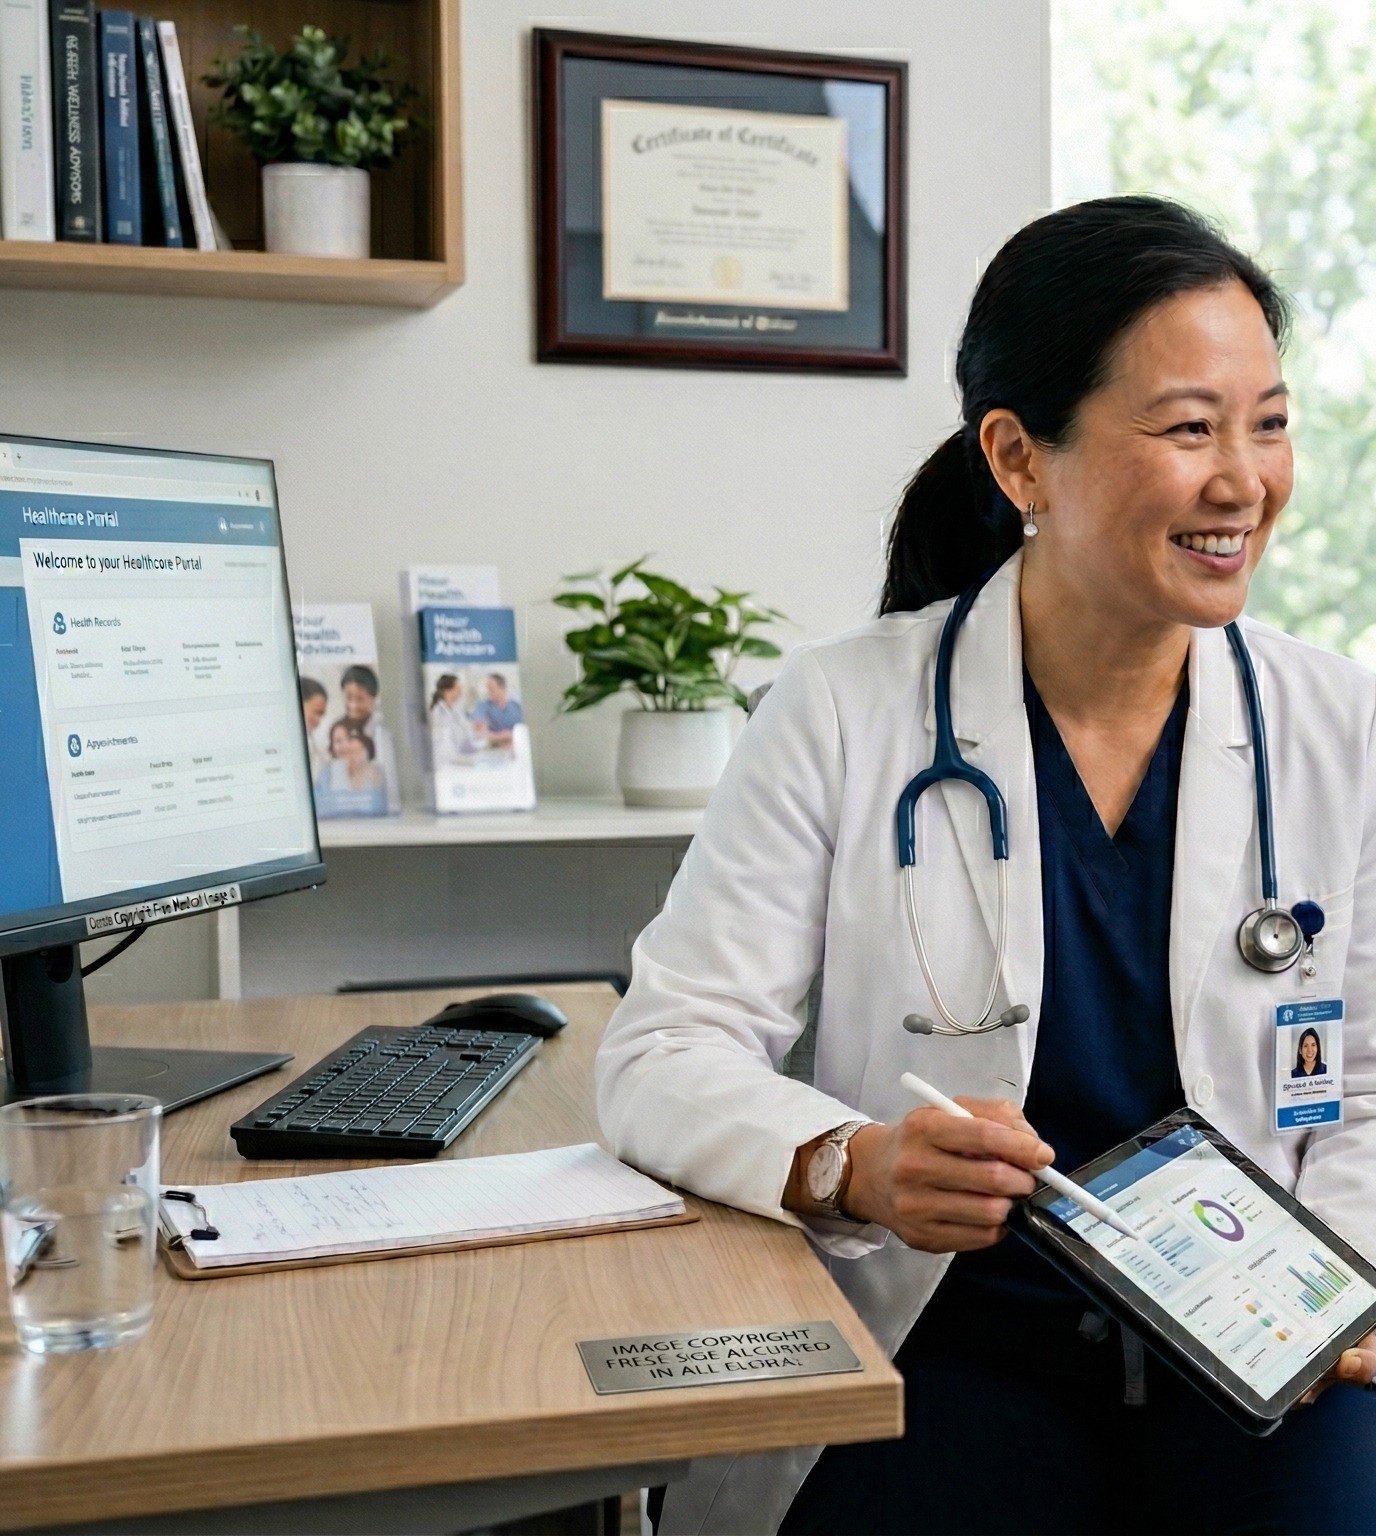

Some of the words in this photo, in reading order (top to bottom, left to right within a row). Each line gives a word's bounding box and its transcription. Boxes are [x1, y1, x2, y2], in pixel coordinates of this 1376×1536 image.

[33, 551, 84, 570] Welcome
[86, 555, 97, 570] to
[99, 557, 120, 573] your
[70, 617, 93, 628] Health
[94, 617, 121, 627] Records
[613, 1339, 684, 1355] IMAGE
[687, 1329, 810, 1349] COPYRIGHT
[650, 1368, 674, 1379] IN
[681, 1362, 720, 1376] ALL
